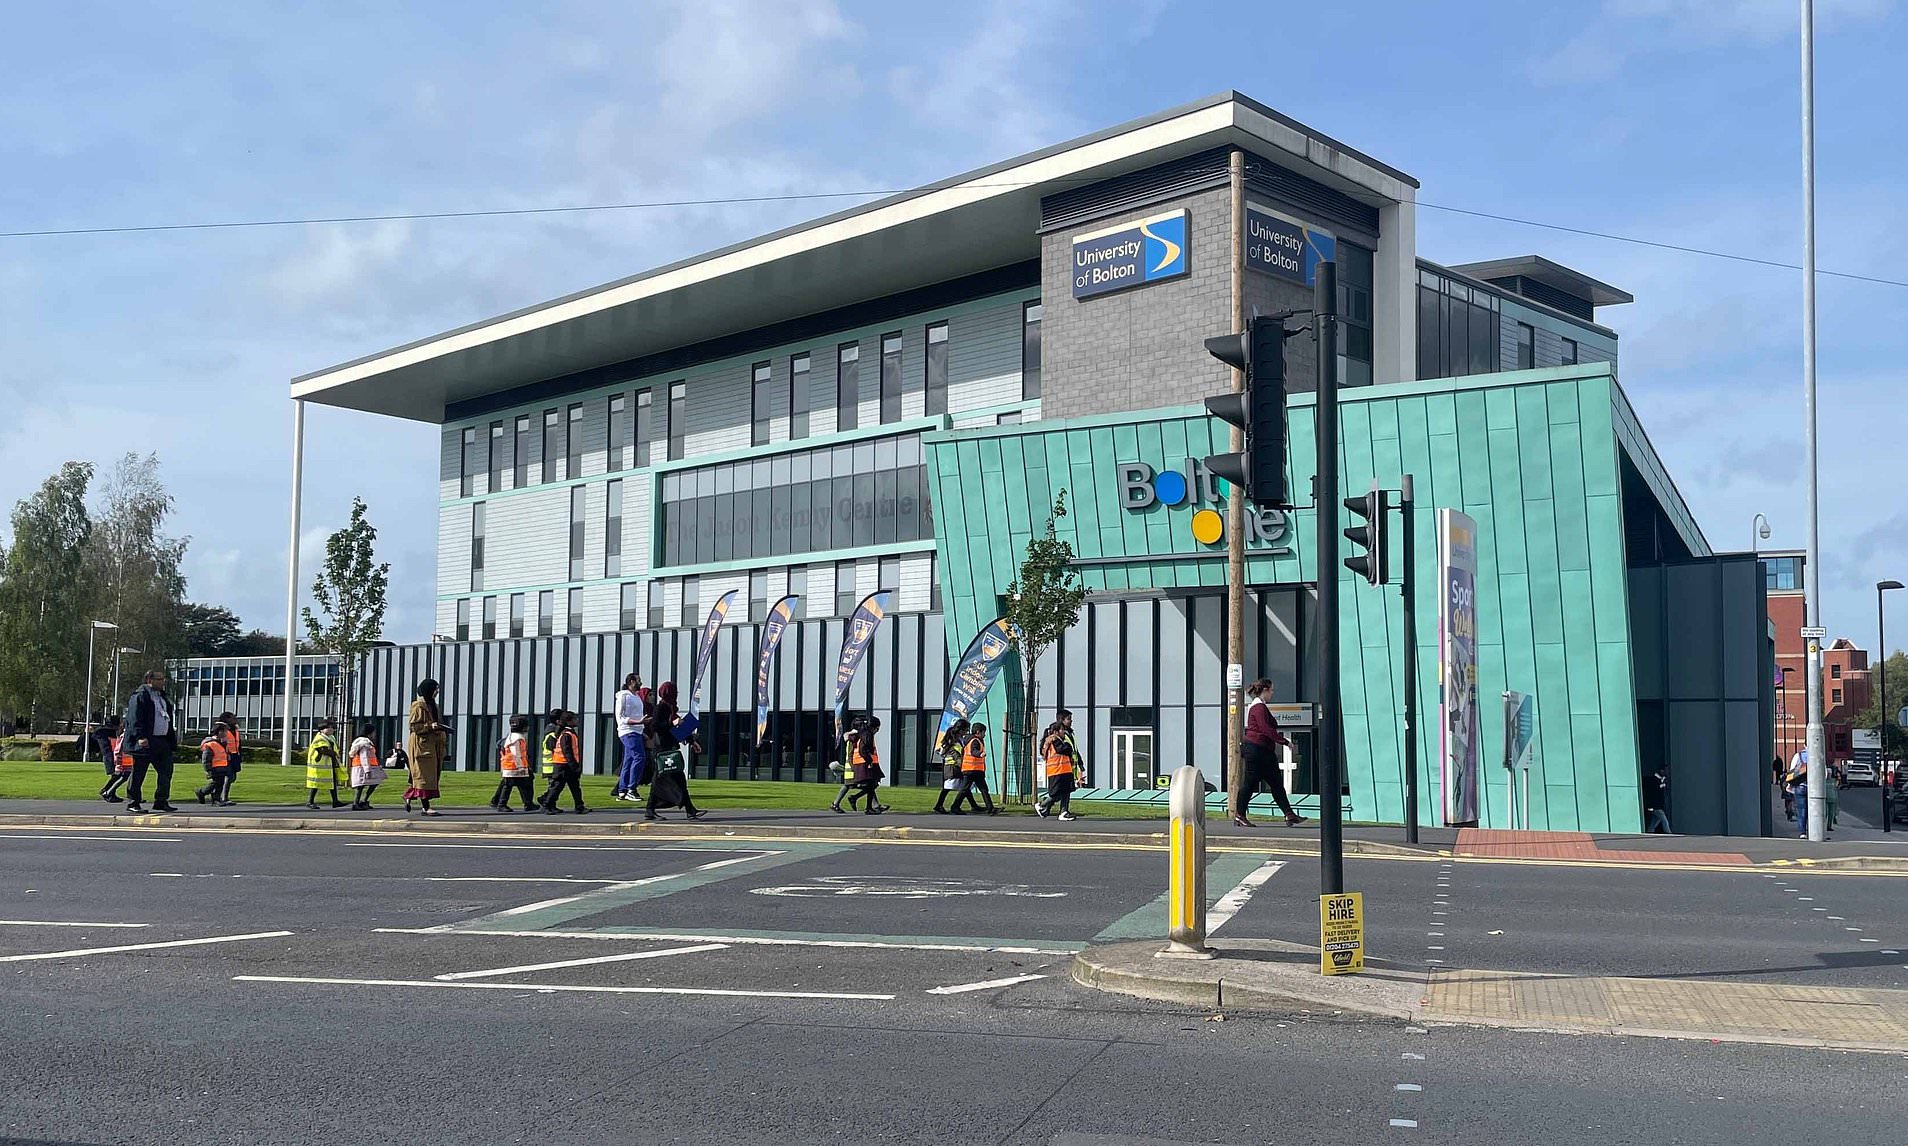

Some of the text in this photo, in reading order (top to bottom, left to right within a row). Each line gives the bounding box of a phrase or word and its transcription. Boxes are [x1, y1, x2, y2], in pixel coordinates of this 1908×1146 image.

[1250, 219, 1302, 256] University
[1076, 240, 1141, 267] University
[1249, 244, 1298, 272] of Bolton
[1076, 264, 1135, 287] of Bolton
[838, 494, 914, 521] Centre
[1810, 645, 1816, 653] 3
[960, 671, 986, 692] Climbing
[962, 681, 977, 695] Wall
[1282, 713, 1302, 721] Health
[1328, 898, 1354, 910] SKIP
[1329, 908, 1355, 921] HIRE
